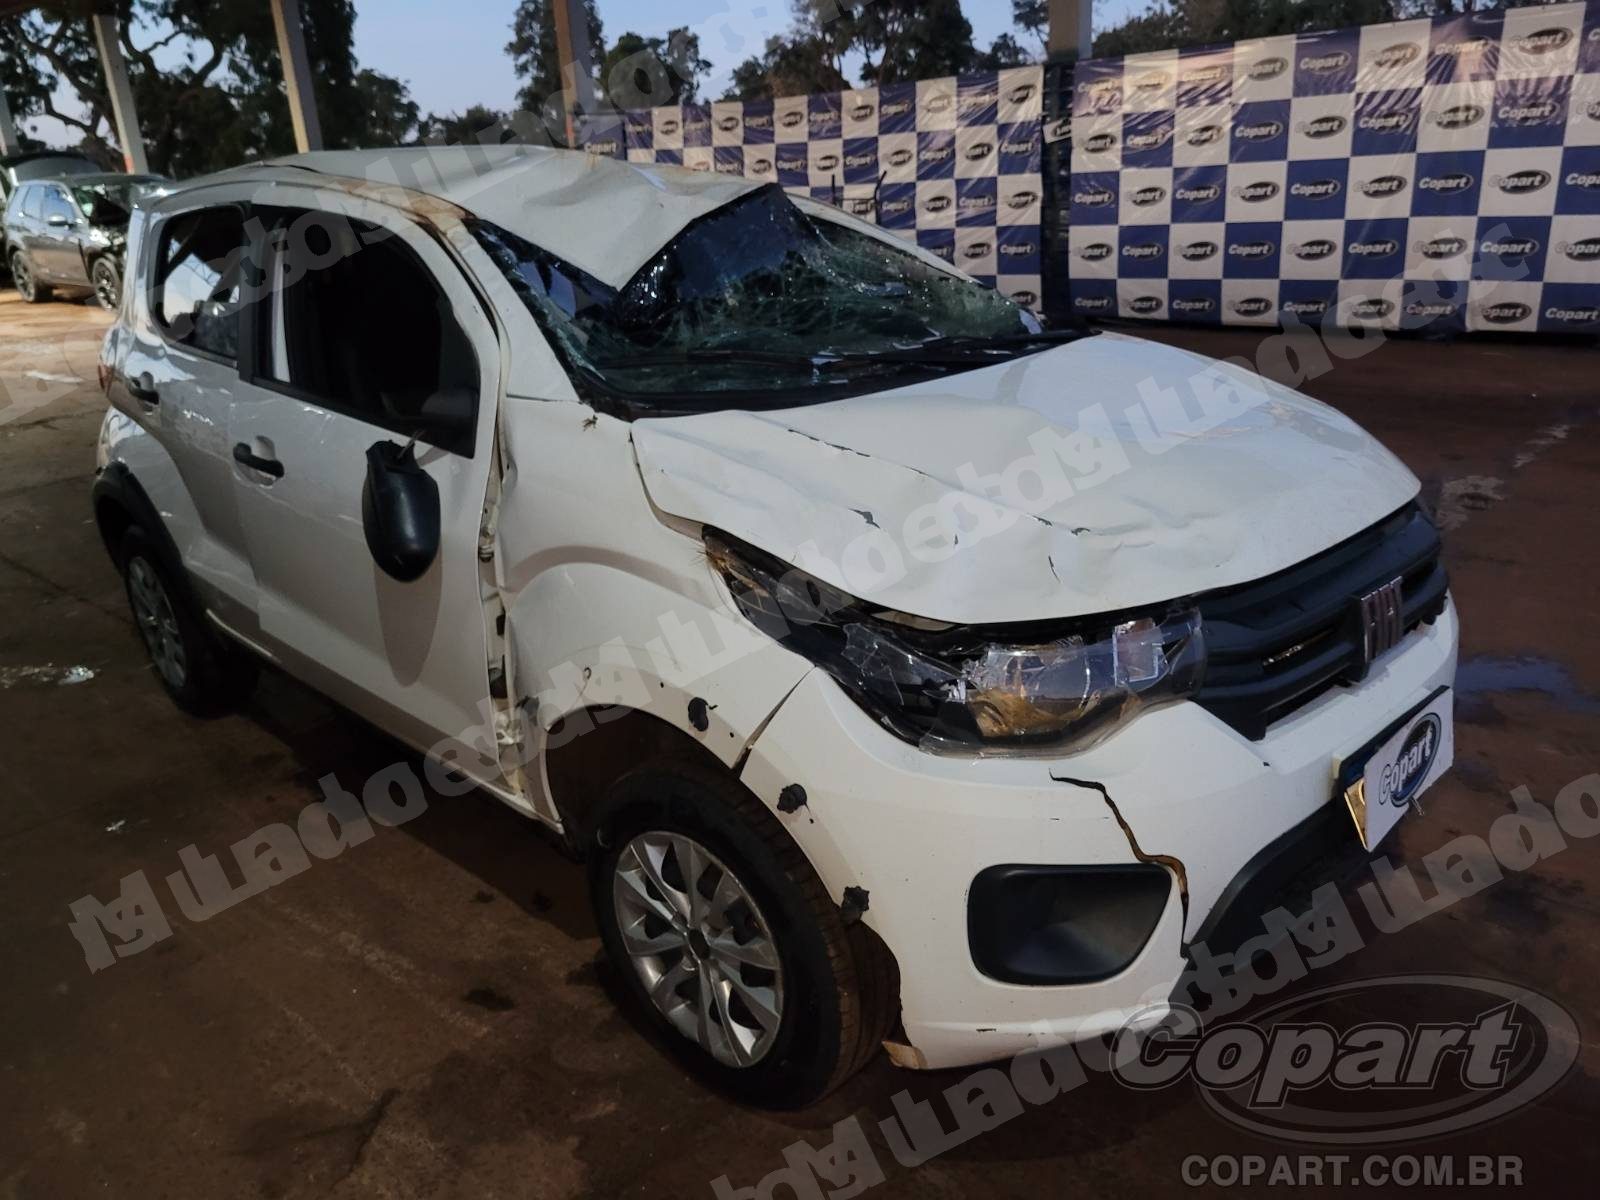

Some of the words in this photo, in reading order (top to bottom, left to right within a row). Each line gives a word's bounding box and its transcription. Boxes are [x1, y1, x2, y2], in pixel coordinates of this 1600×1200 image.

[1300, 54, 1345, 72] Copart
[1500, 103, 1553, 121] Copart
[1360, 115, 1406, 131] Copart
[1235, 123, 1277, 138] Copart
[1291, 181, 1337, 197] Copart
[1419, 176, 1468, 192] Copart
[1074, 192, 1110, 205] Copart
[1176, 186, 1216, 201] Copart
[1122, 244, 1159, 258] Copart
[1228, 243, 1269, 257] Copart
[1348, 242, 1394, 256] Copart
[1481, 241, 1534, 257] Copart
[1075, 297, 1108, 310] Copart
[1172, 299, 1209, 312] Copart
[1283, 301, 1326, 315] Copart
[1407, 302, 1450, 316] Copart
[1545, 307, 1598, 321] Copart
[1379, 727, 1433, 805] Copart
